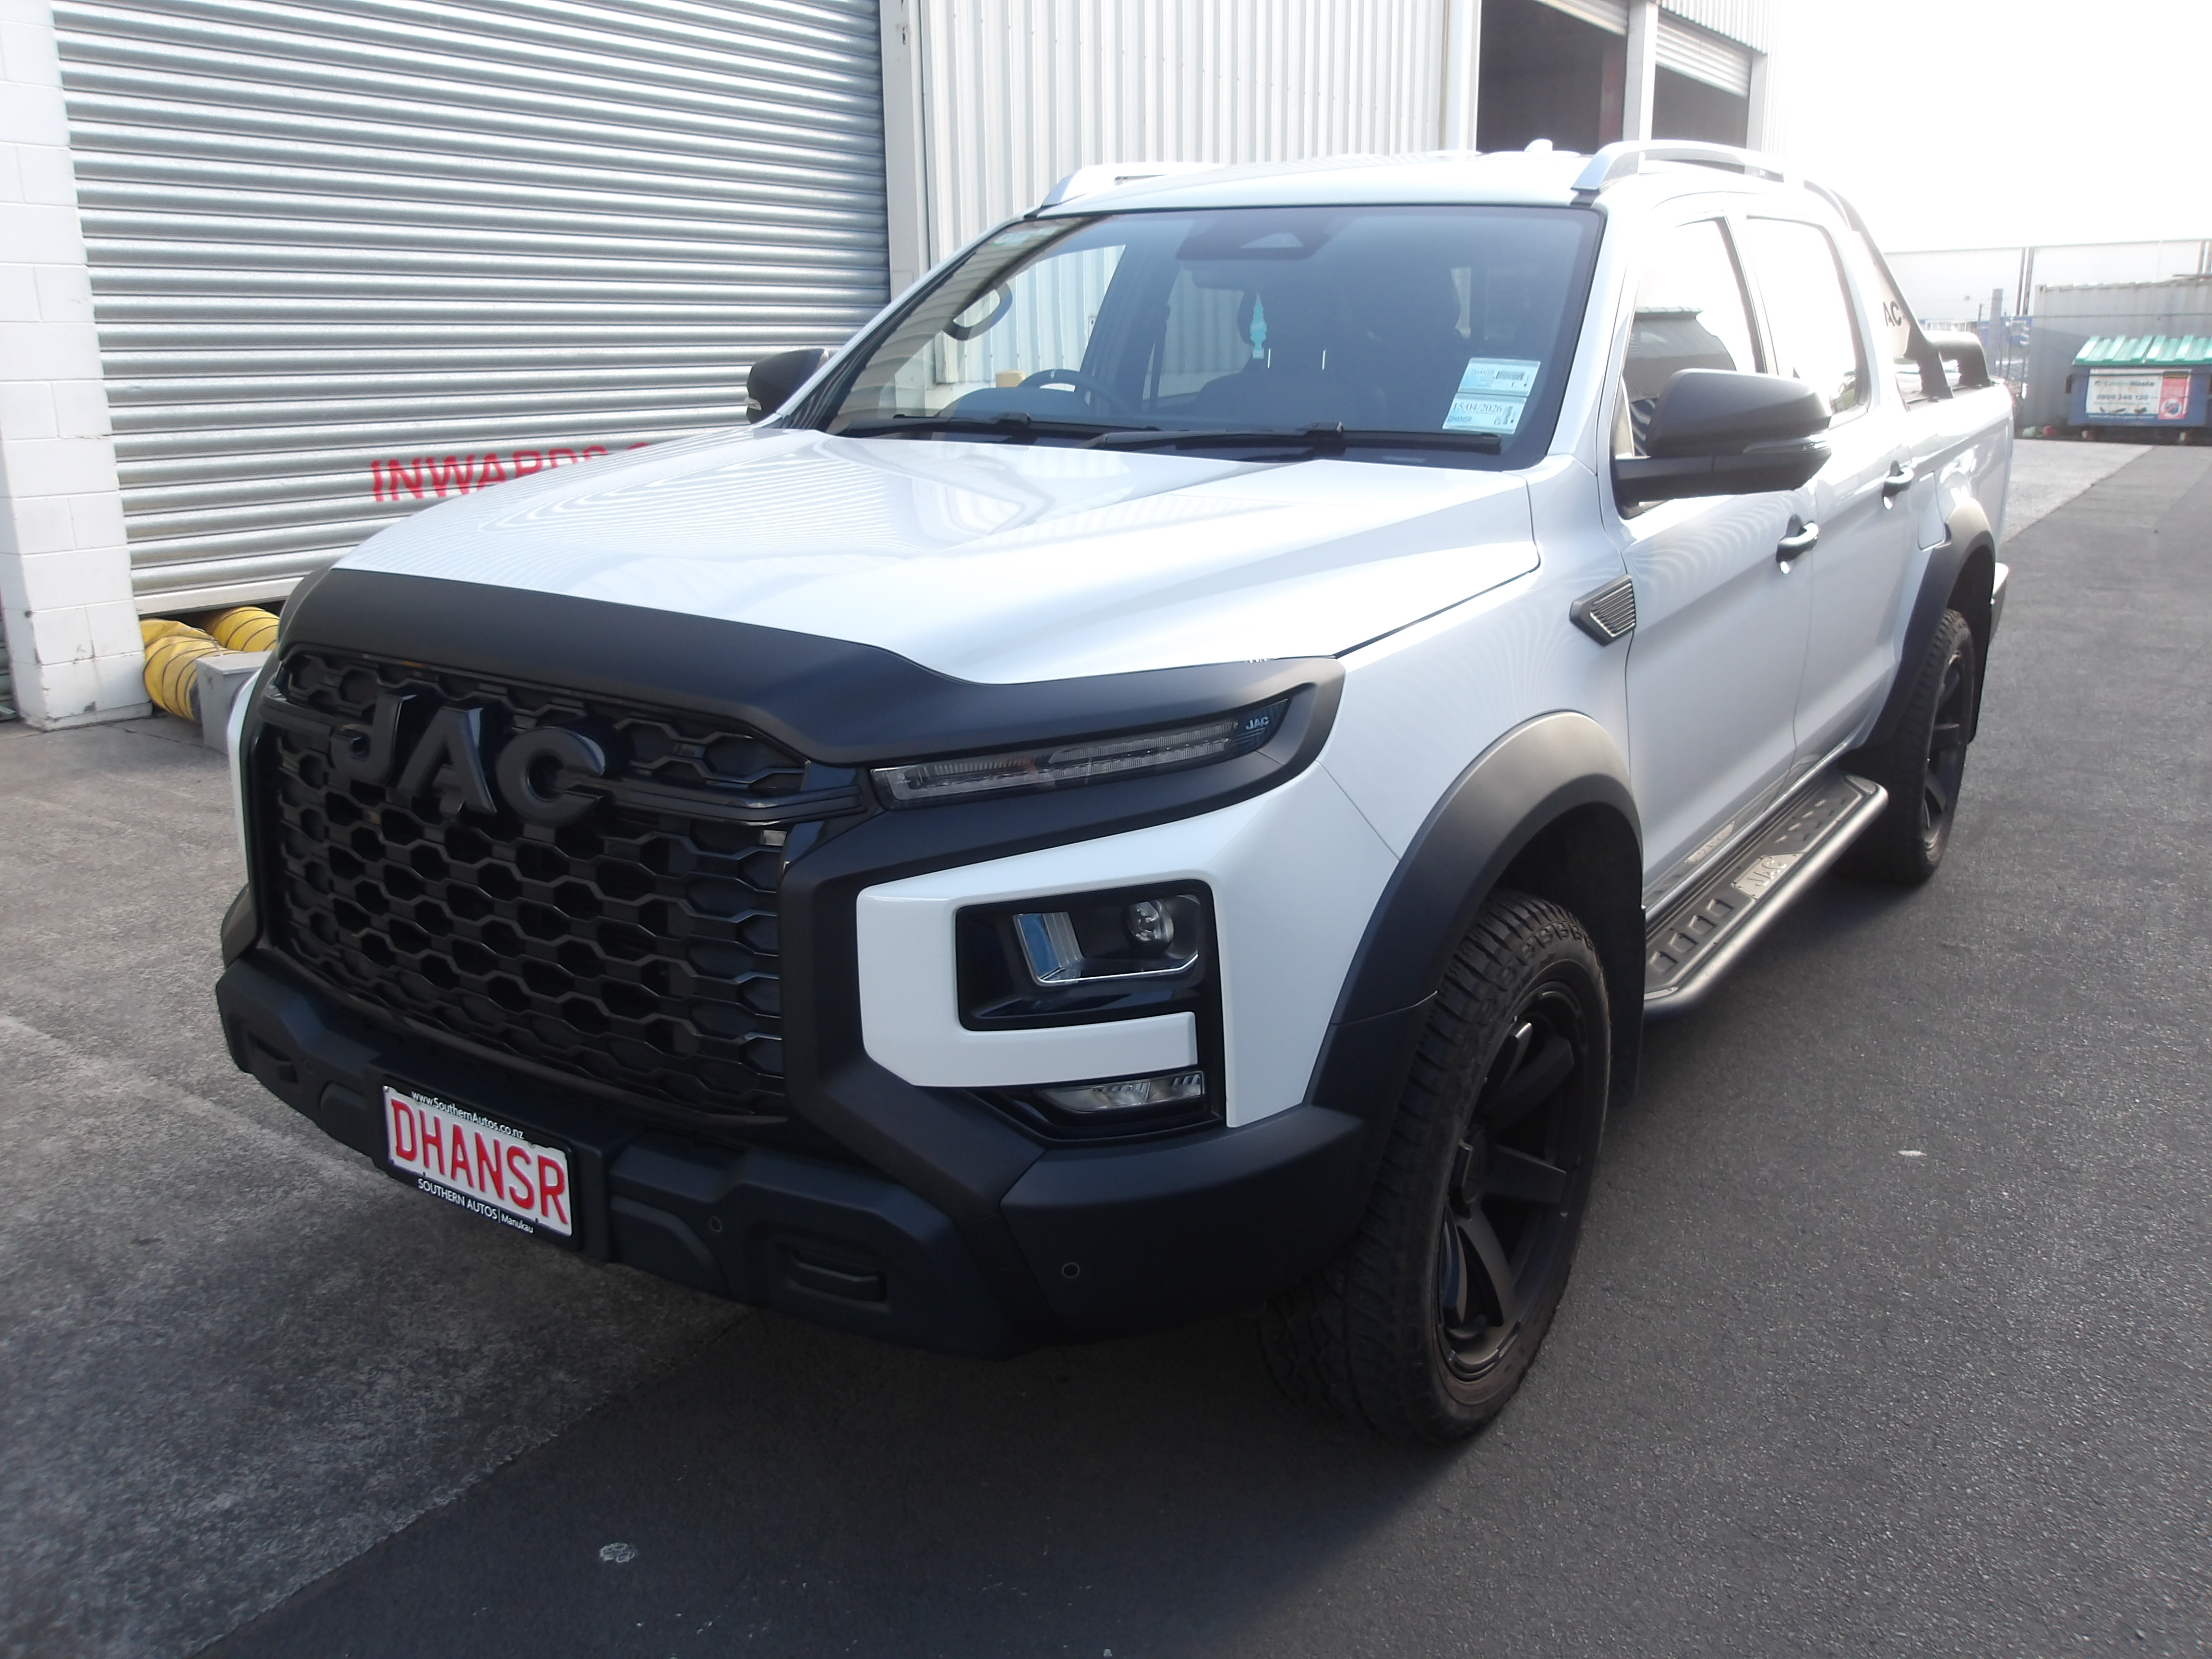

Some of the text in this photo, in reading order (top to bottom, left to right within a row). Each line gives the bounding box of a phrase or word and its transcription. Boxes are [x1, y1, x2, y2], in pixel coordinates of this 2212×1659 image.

[1454, 402, 1502, 412] 15/04/2026
[1245, 716, 1270, 730] JAC
[331, 694, 606, 827] JAC
[411, 1091, 525, 1140] www.SouthernAutos.co.nz
[391, 1098, 569, 1225] DHANSR
[419, 1178, 465, 1207] SOUTHERN
[501, 1213, 534, 1234] Manukau
